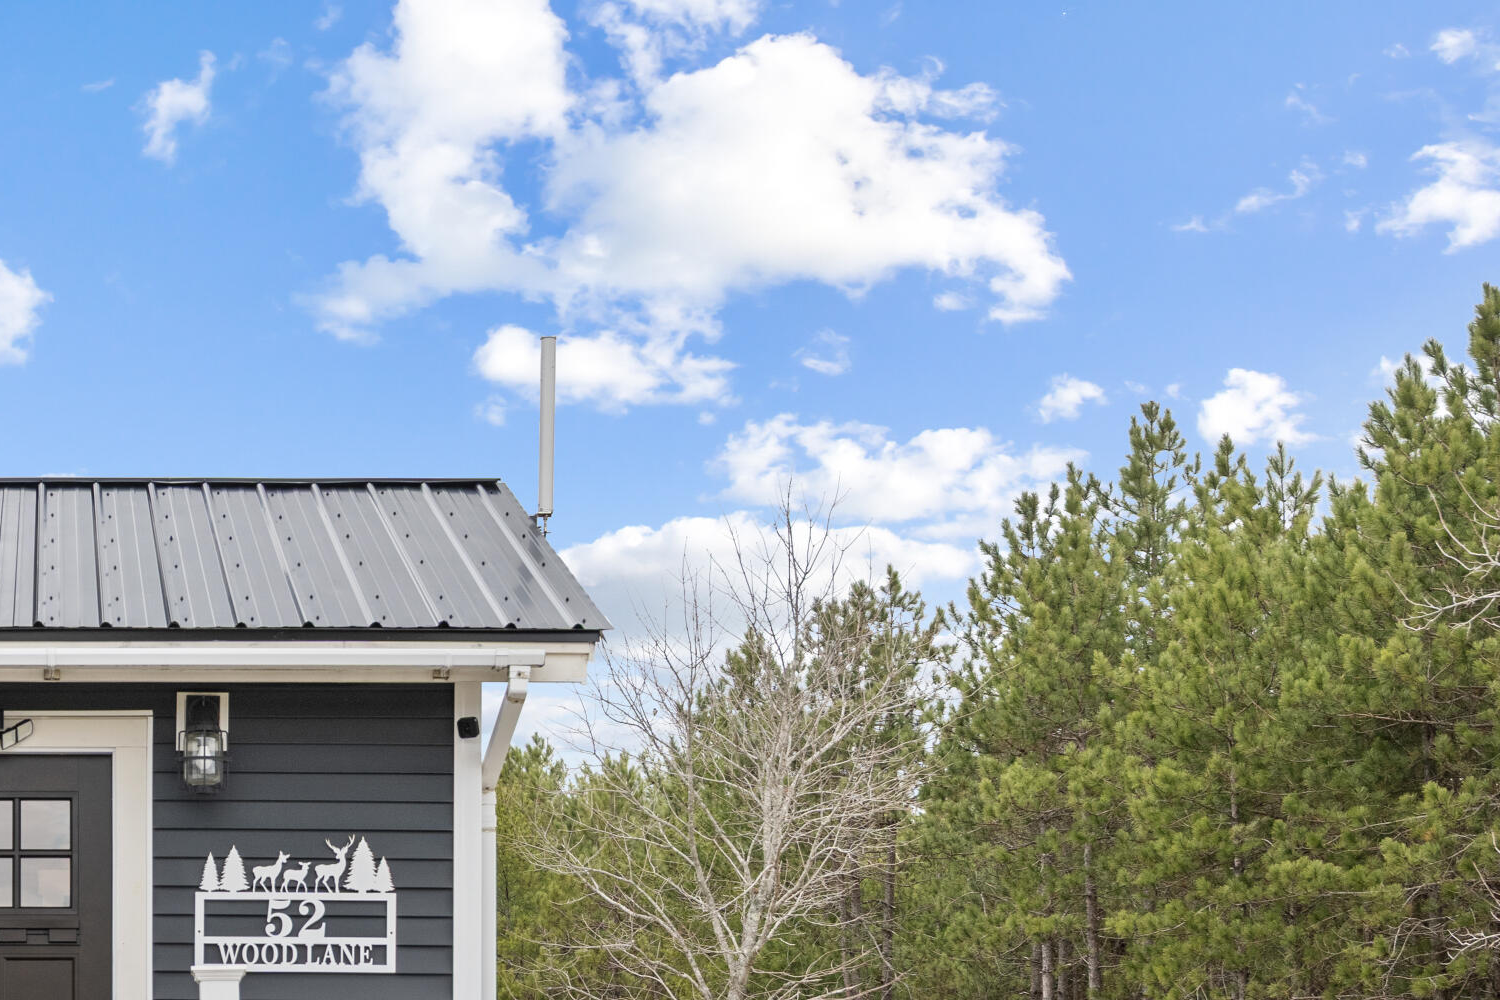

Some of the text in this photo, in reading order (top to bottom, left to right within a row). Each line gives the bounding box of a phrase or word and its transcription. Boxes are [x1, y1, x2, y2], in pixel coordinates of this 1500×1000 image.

[265, 900, 326, 938] 52
[217, 943, 373, 966] WOOD LANE
